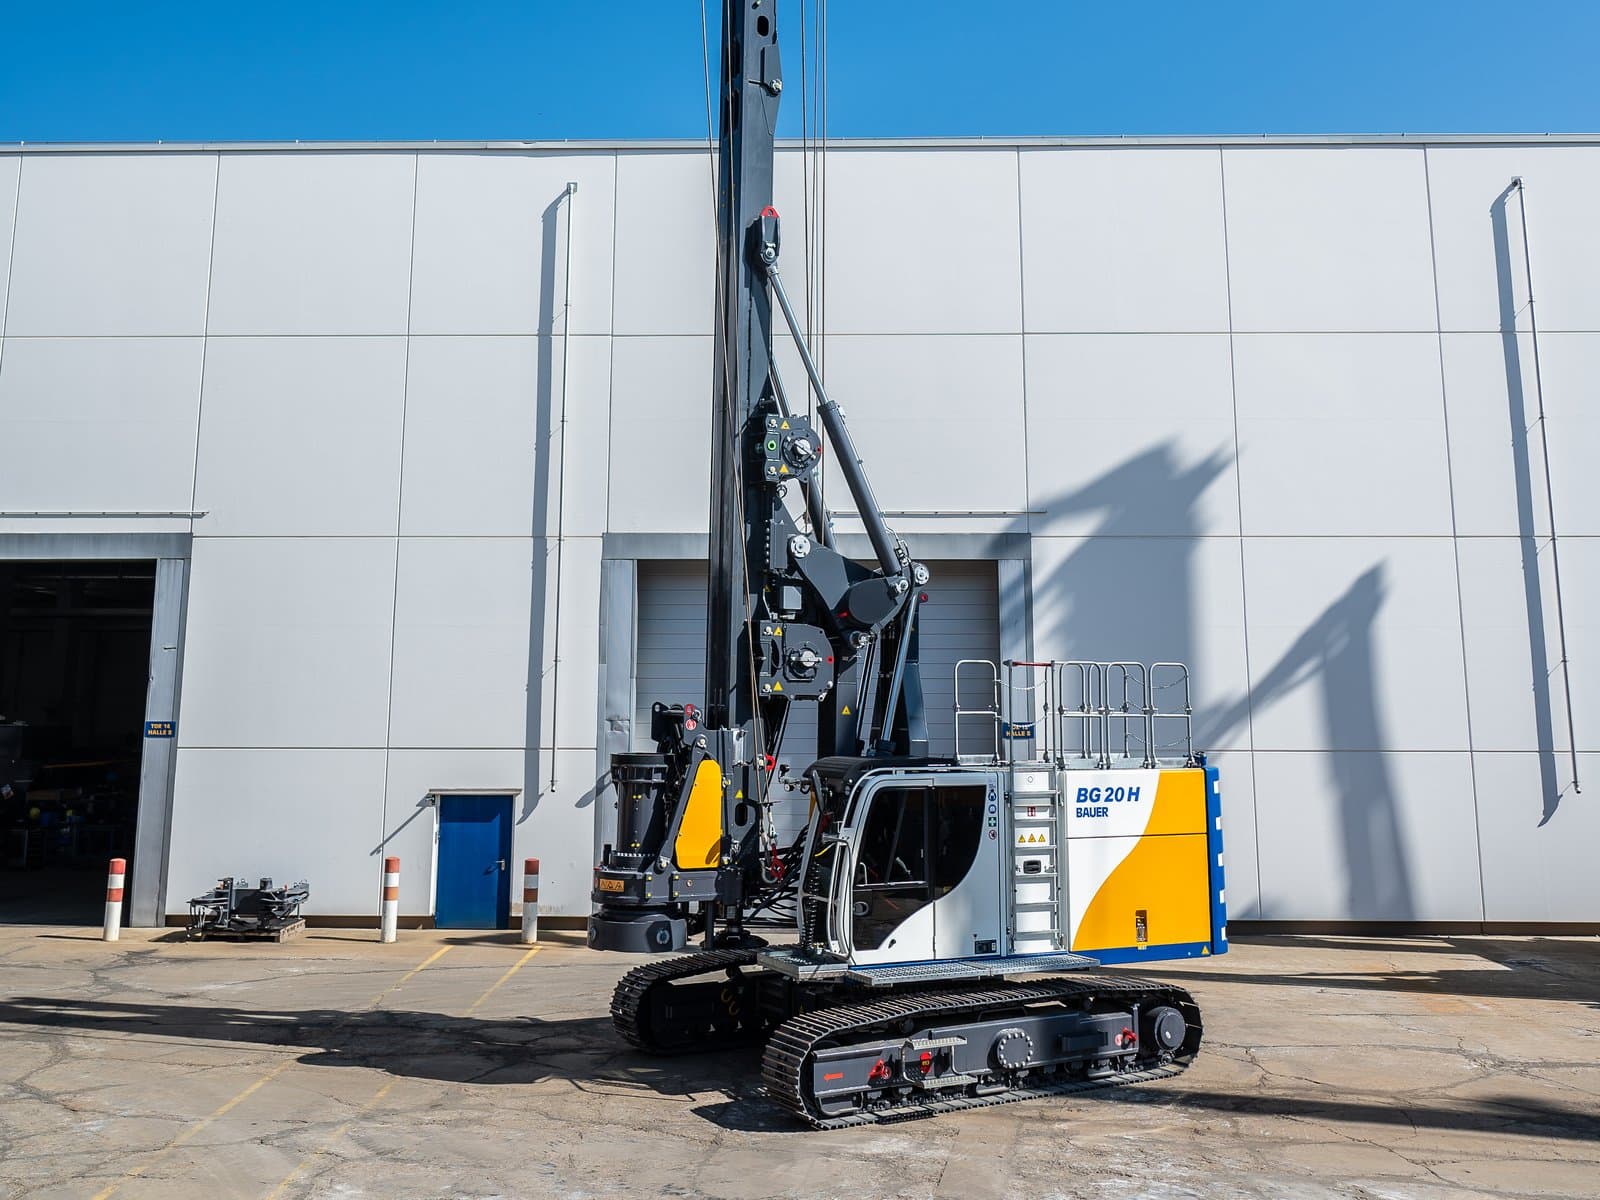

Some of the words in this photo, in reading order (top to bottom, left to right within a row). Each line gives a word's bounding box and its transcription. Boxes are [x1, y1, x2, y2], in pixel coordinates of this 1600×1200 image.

[1076, 787, 1101, 803] BG
[1104, 787, 1125, 802] 20
[1127, 786, 1140, 802] H
[1076, 807, 1109, 818] BAUER
